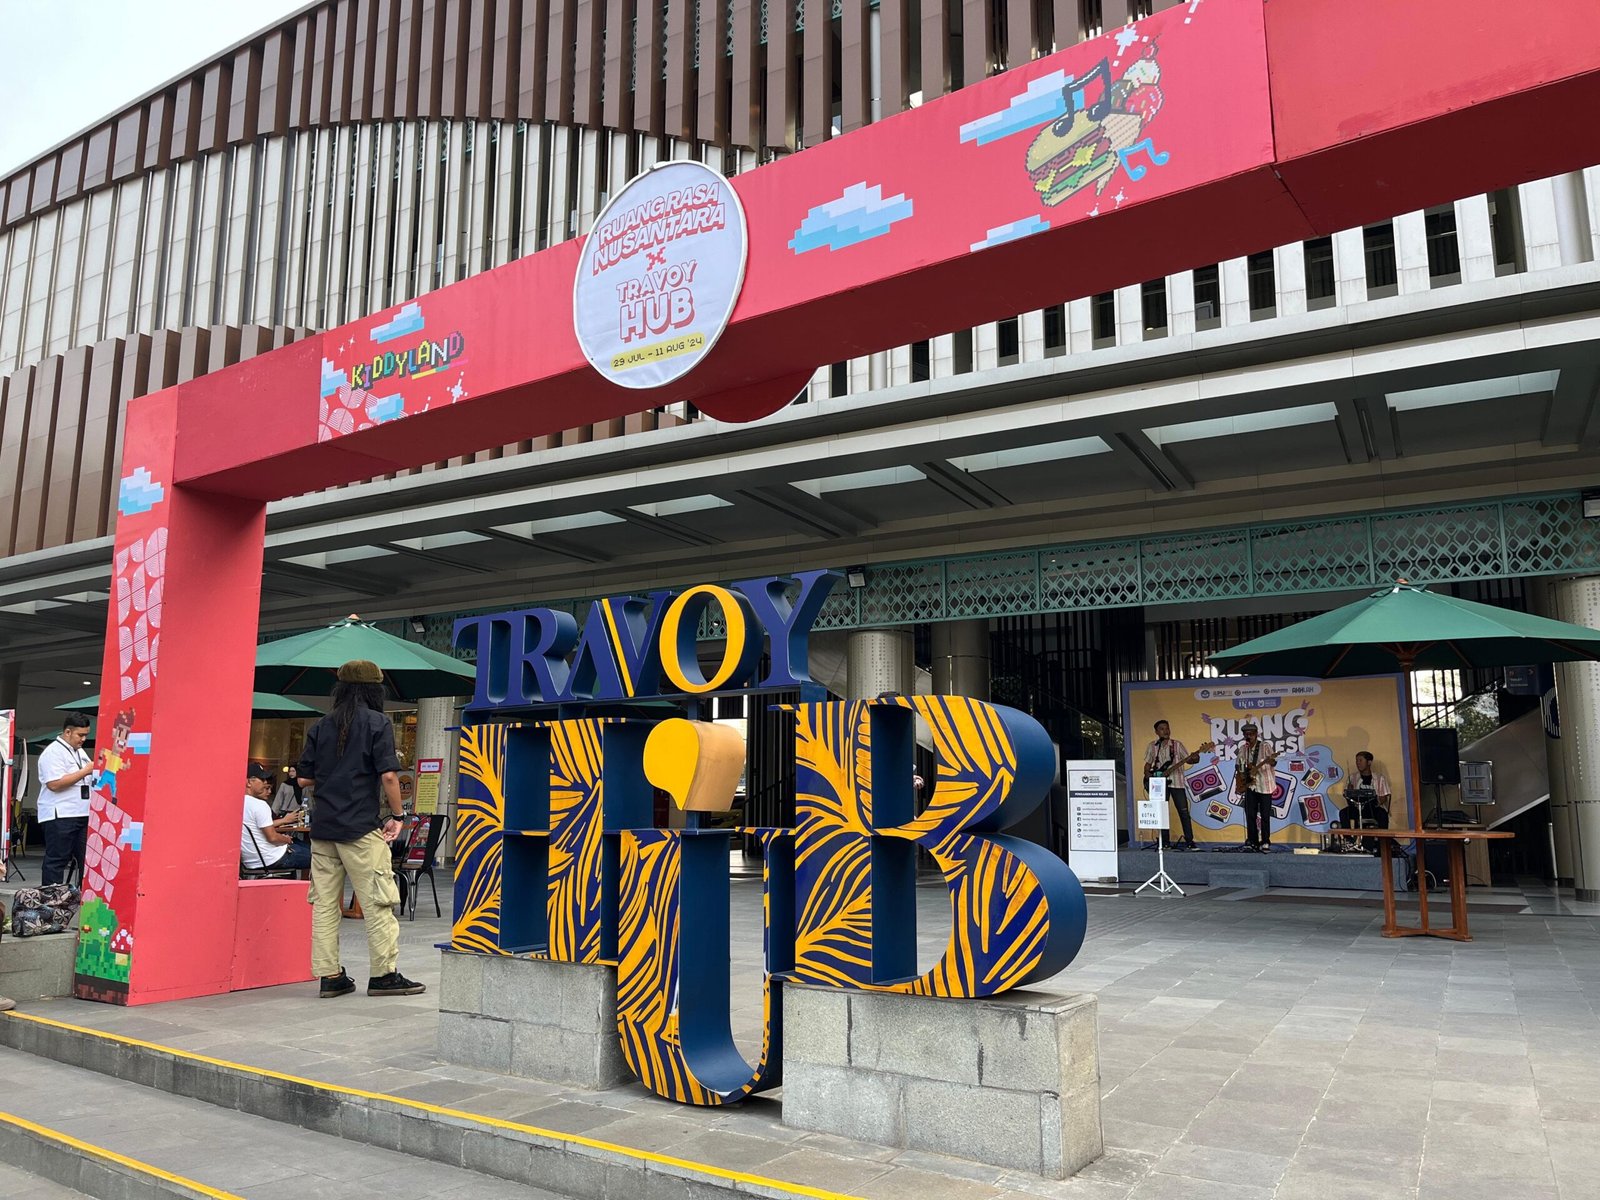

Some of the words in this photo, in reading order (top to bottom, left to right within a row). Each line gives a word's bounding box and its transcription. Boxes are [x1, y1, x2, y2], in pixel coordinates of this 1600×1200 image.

[592, 203, 726, 276] NUSANTARA
[599, 196, 664, 249] RUANG
[664, 182, 720, 217] RASA
[616, 259, 698, 304] TRAVOY
[619, 287, 695, 344] HUB
[351, 331, 465, 391] KIDDYLAND
[613, 358, 625, 368] 29
[627, 353, 645, 364] JUL
[655, 348, 664, 358] 11
[666, 341, 685, 353] AUG
[453, 569, 846, 709] TRAVOY
[1210, 708, 1309, 744] RUANG
[445, 694, 1088, 1106] HUB
